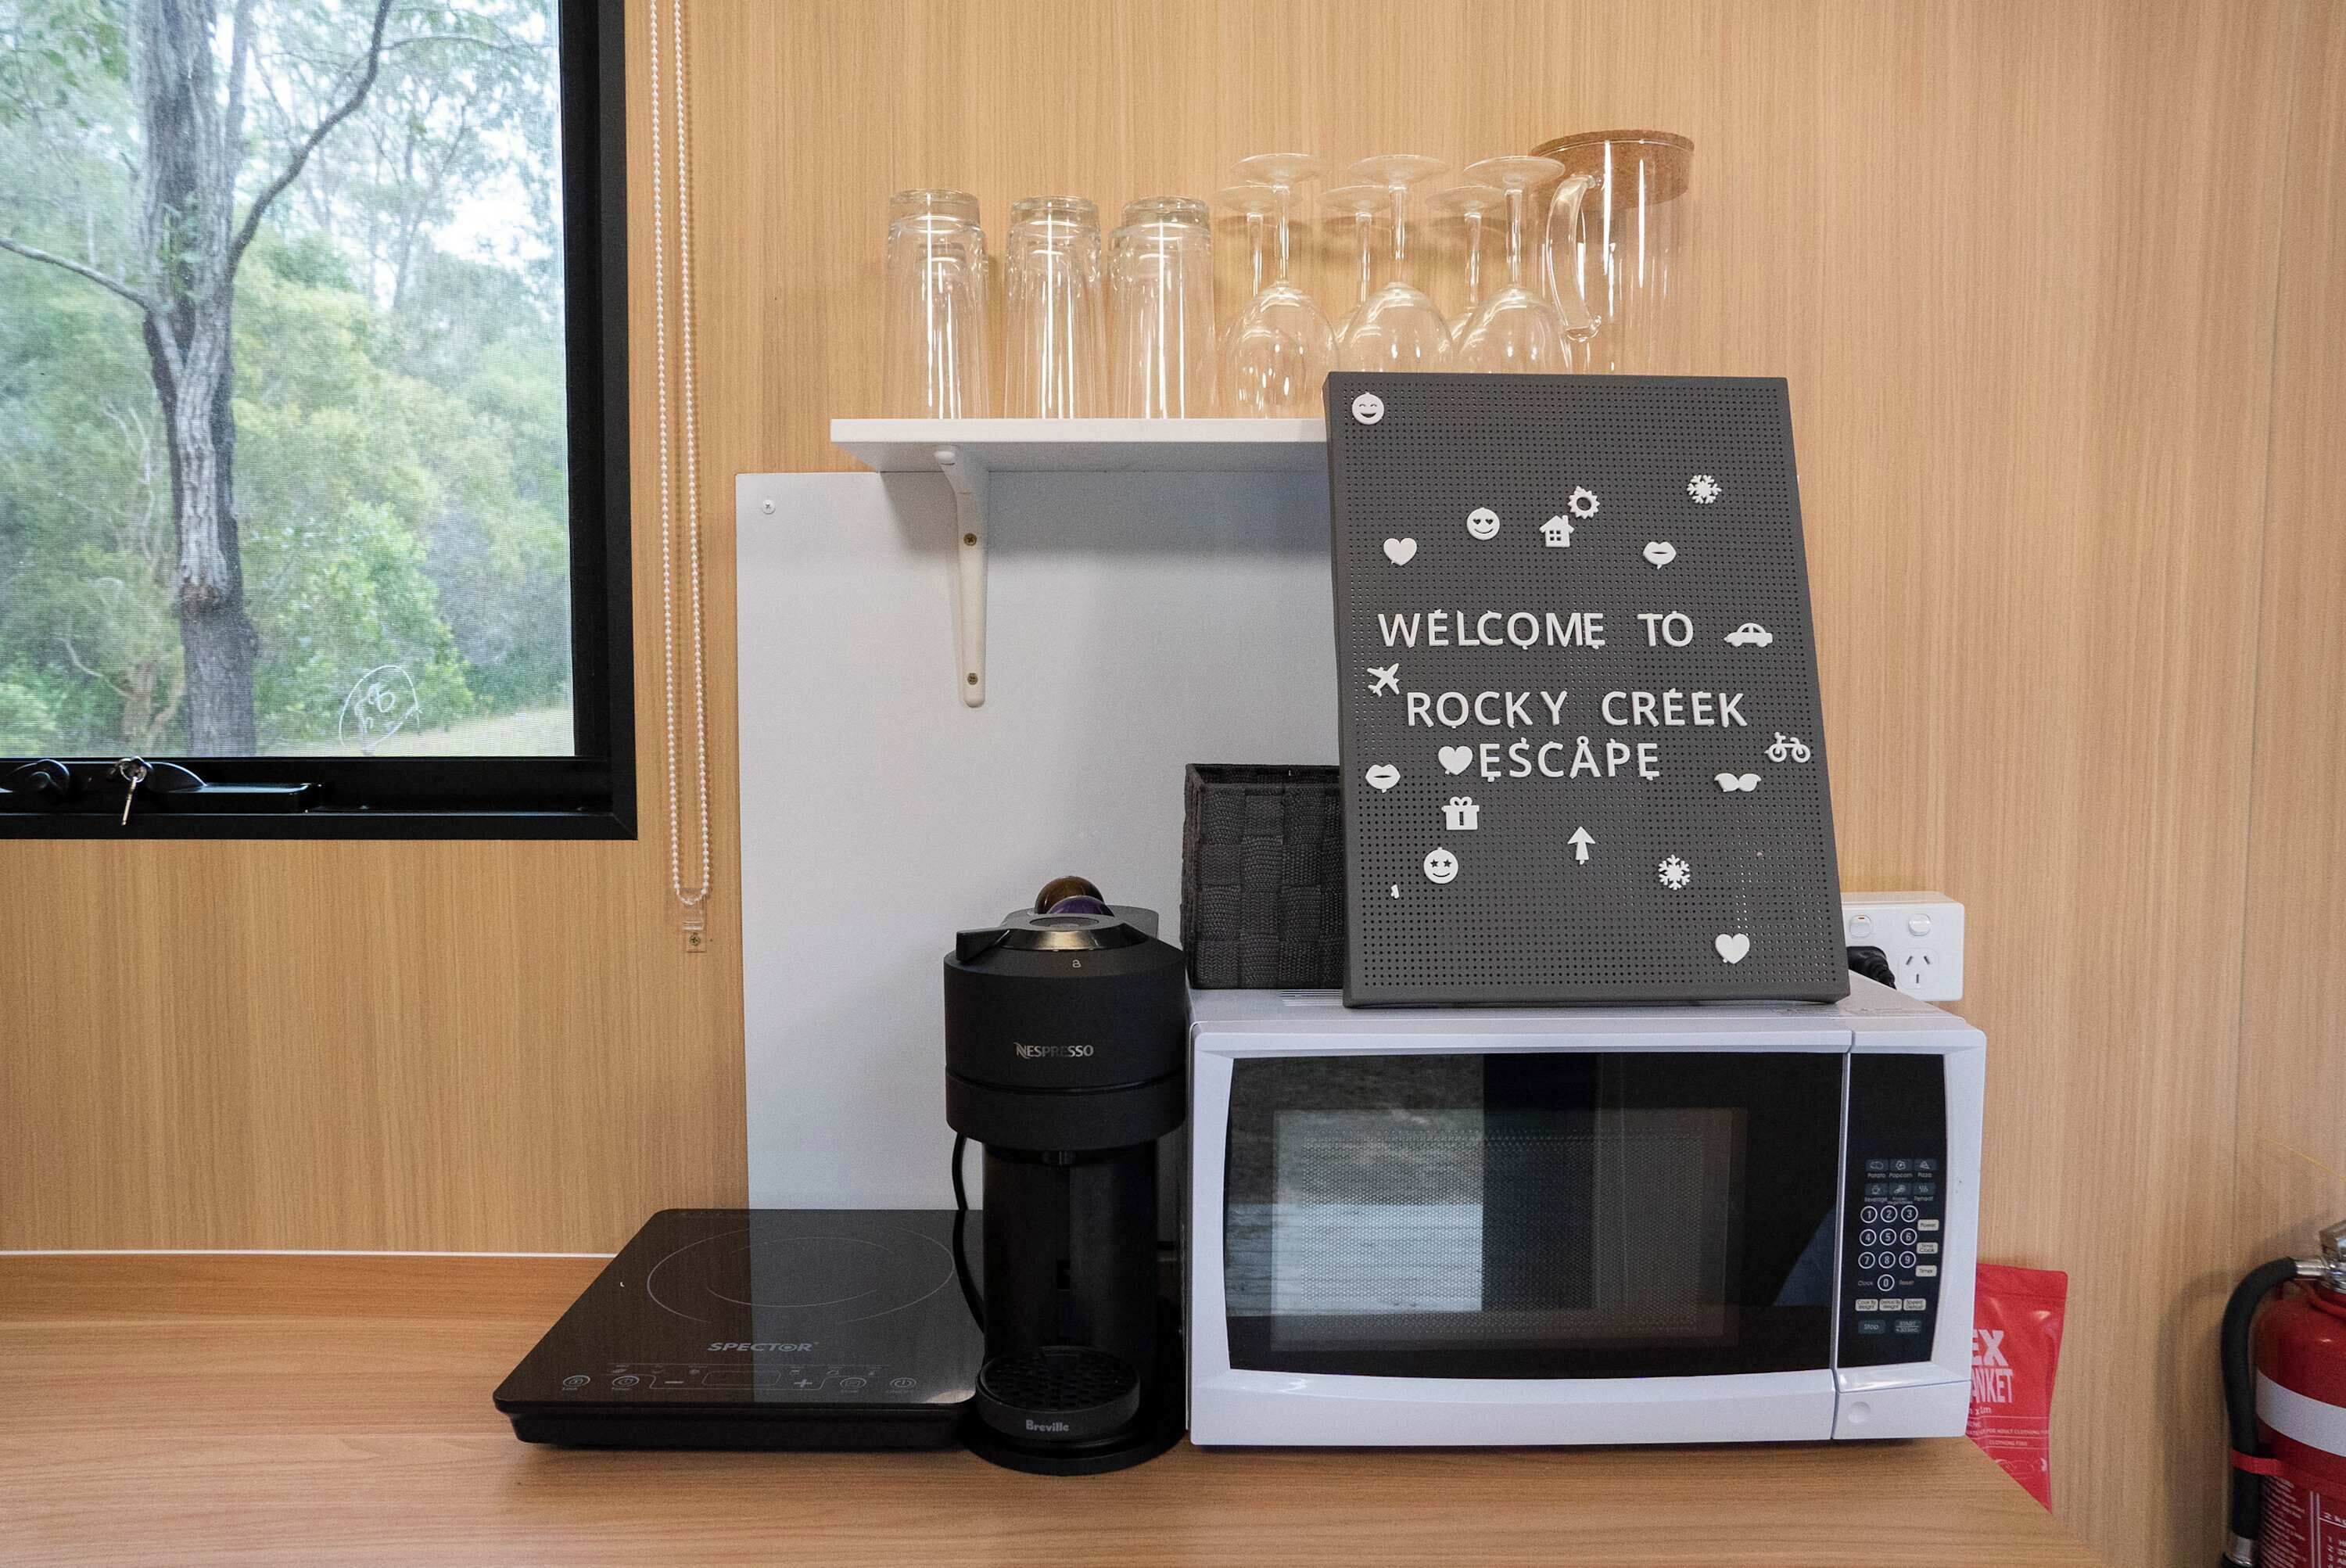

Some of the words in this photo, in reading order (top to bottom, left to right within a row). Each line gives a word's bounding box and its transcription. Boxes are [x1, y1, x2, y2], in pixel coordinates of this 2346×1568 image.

[1377, 610, 1605, 648] WELCOME
[1637, 611, 1694, 648] TO
[1407, 691, 1567, 728] ROCKY
[1602, 689, 1748, 728] CREEK
[1480, 739, 1660, 780] ESCAPE
[1013, 1042, 1093, 1059] NESPRESSO
[707, 1343, 813, 1351] SPECTOR
[1026, 1419, 1069, 1431] Breville
